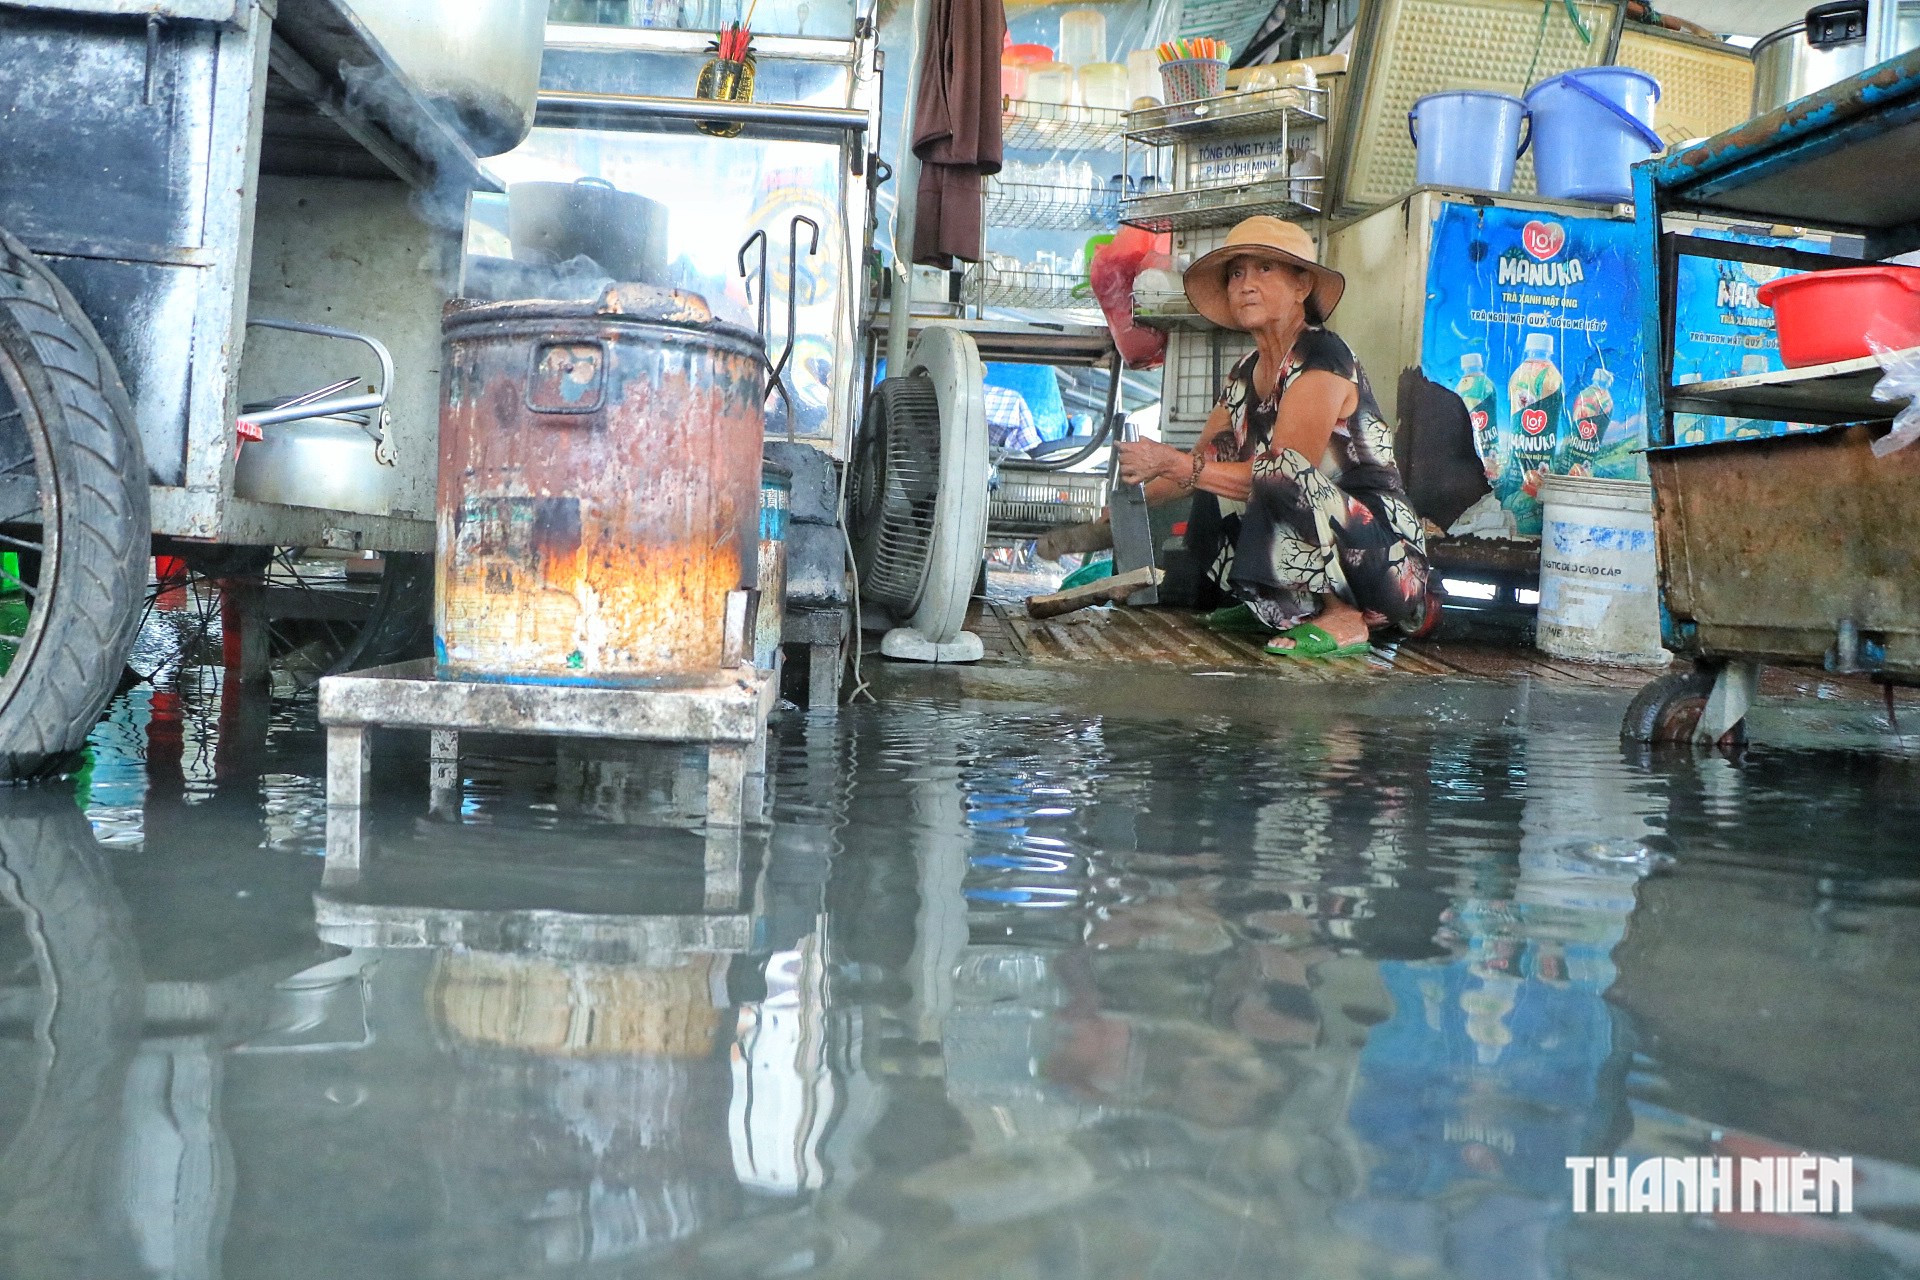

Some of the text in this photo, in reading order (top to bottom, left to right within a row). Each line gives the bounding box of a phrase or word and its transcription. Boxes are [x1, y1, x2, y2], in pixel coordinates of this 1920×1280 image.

[1253, 142, 1265, 154] TY
[1252, 160, 1276, 172] MINH
[1499, 256, 1584, 286] MANUKA
[1502, 291, 1578, 308] TRÀ XANH MẬT ONG
[1471, 309, 1486, 320] TRÀ
